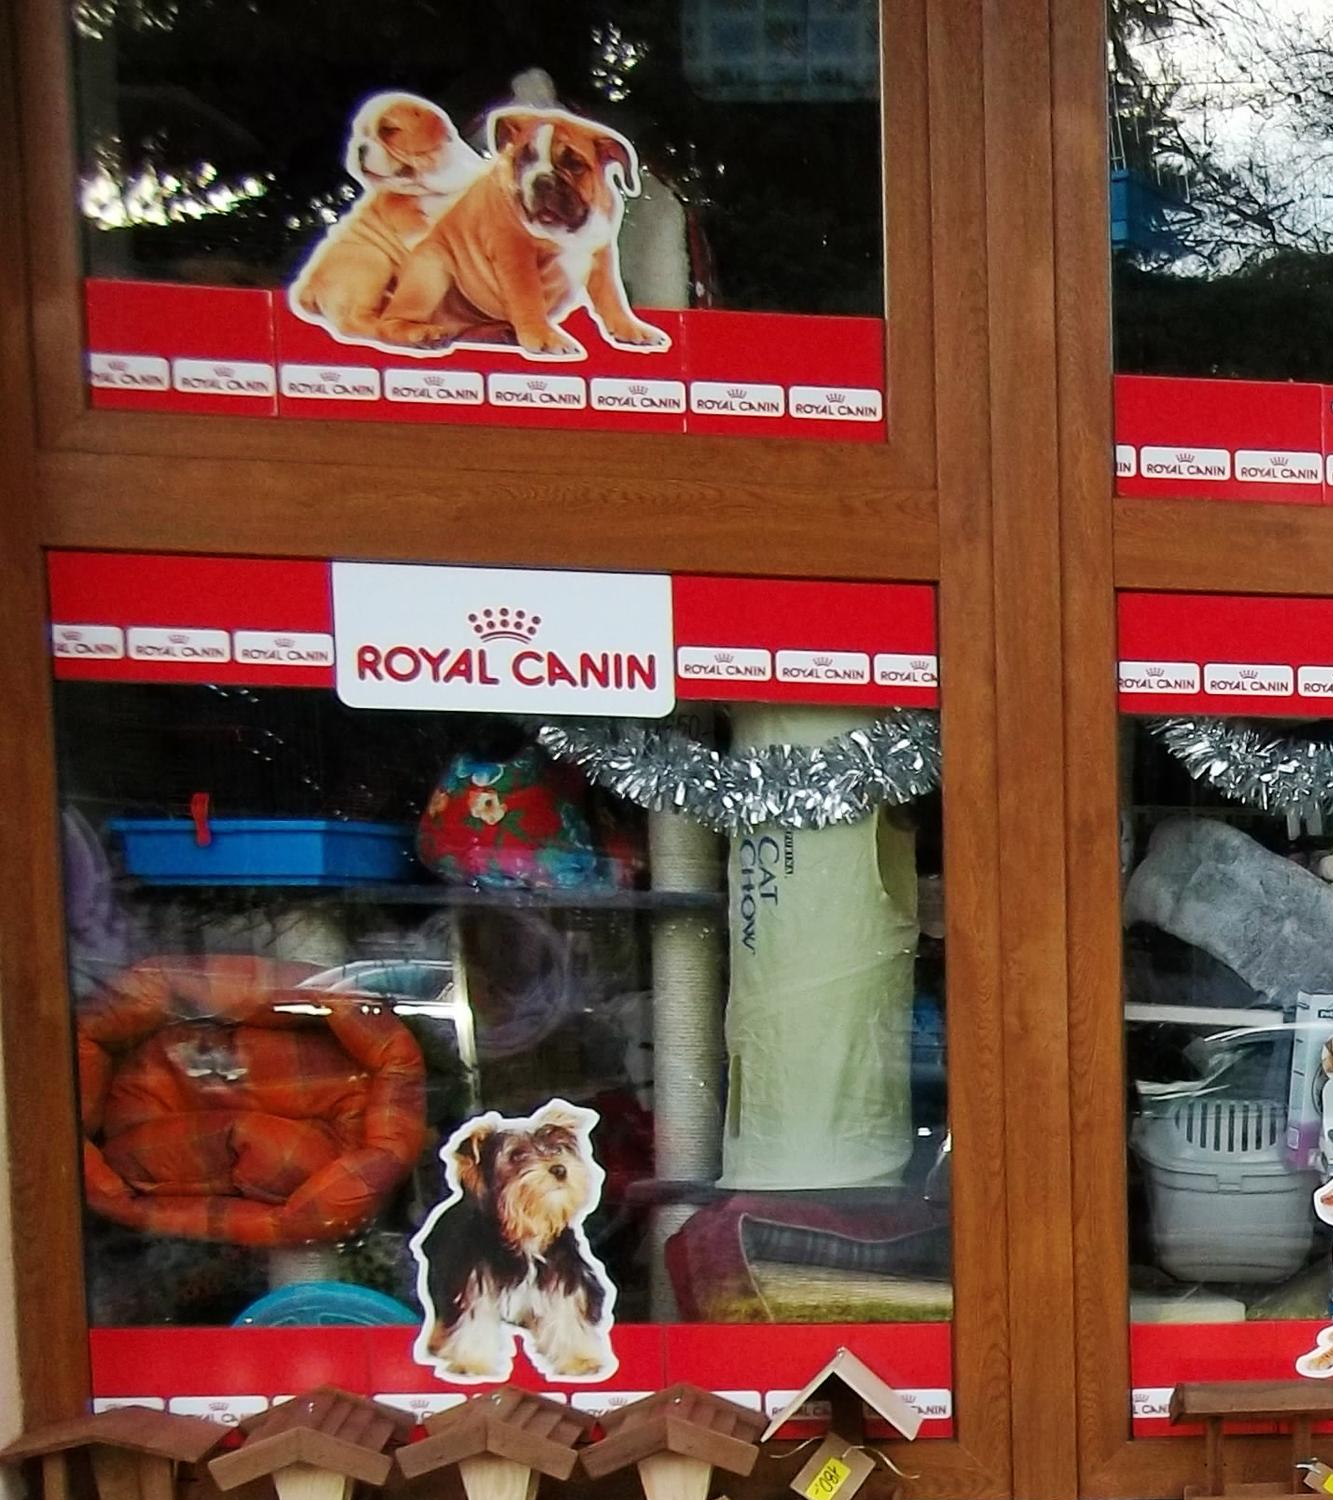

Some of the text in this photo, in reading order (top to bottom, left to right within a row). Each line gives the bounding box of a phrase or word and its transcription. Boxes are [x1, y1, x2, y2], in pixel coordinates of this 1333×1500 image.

[494, 390, 581, 406] ROYAL CANIN
[696, 398, 779, 413] ROYAL CANIN
[795, 402, 877, 418] ROYAL CANIN
[1146, 462, 1184, 476] ROYAL
[1186, 464, 1225, 477] CANIN
[240, 647, 328, 663] ROYAL CANIN
[357, 645, 655, 691] ROYAL CANIN
[683, 662, 766, 677] ROYAL CANIN
[782, 666, 865, 681] ROYAL CANIN
[1209, 679, 1288, 693] ROYAL CANIN
[758, 836, 779, 905] CAT
[740, 839, 755, 955] CHOW
